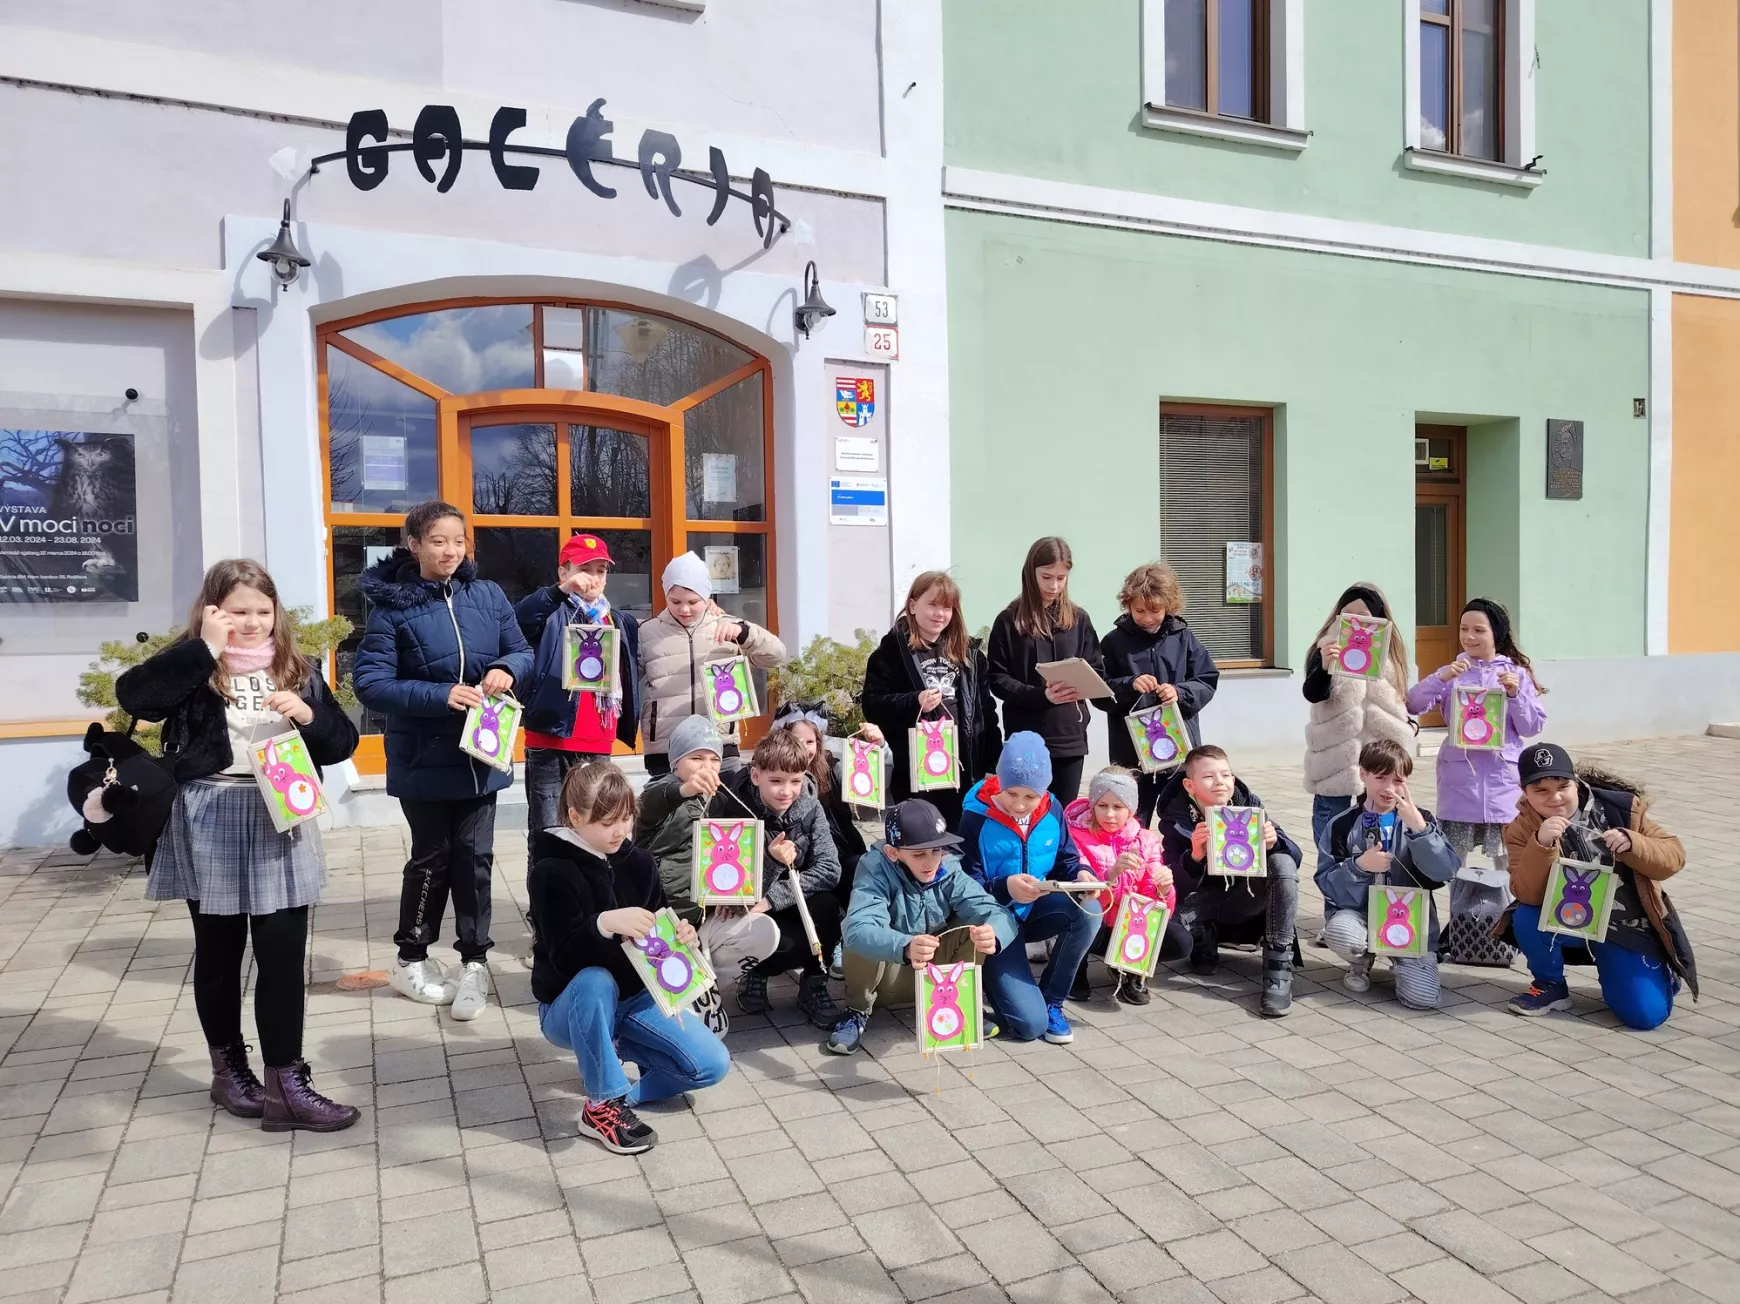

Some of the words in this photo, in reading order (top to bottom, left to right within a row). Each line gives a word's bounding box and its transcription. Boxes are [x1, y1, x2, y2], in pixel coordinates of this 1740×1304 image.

[875, 300, 889, 318] 53
[873, 333, 891, 350] 25
[0, 516, 16, 532] V
[20, 516, 77, 533] moci
[82, 516, 135, 534] noci
[24, 536, 46, 544] 2024
[54, 536, 79, 544] 23.08.
[233, 676, 277, 692] LOS
